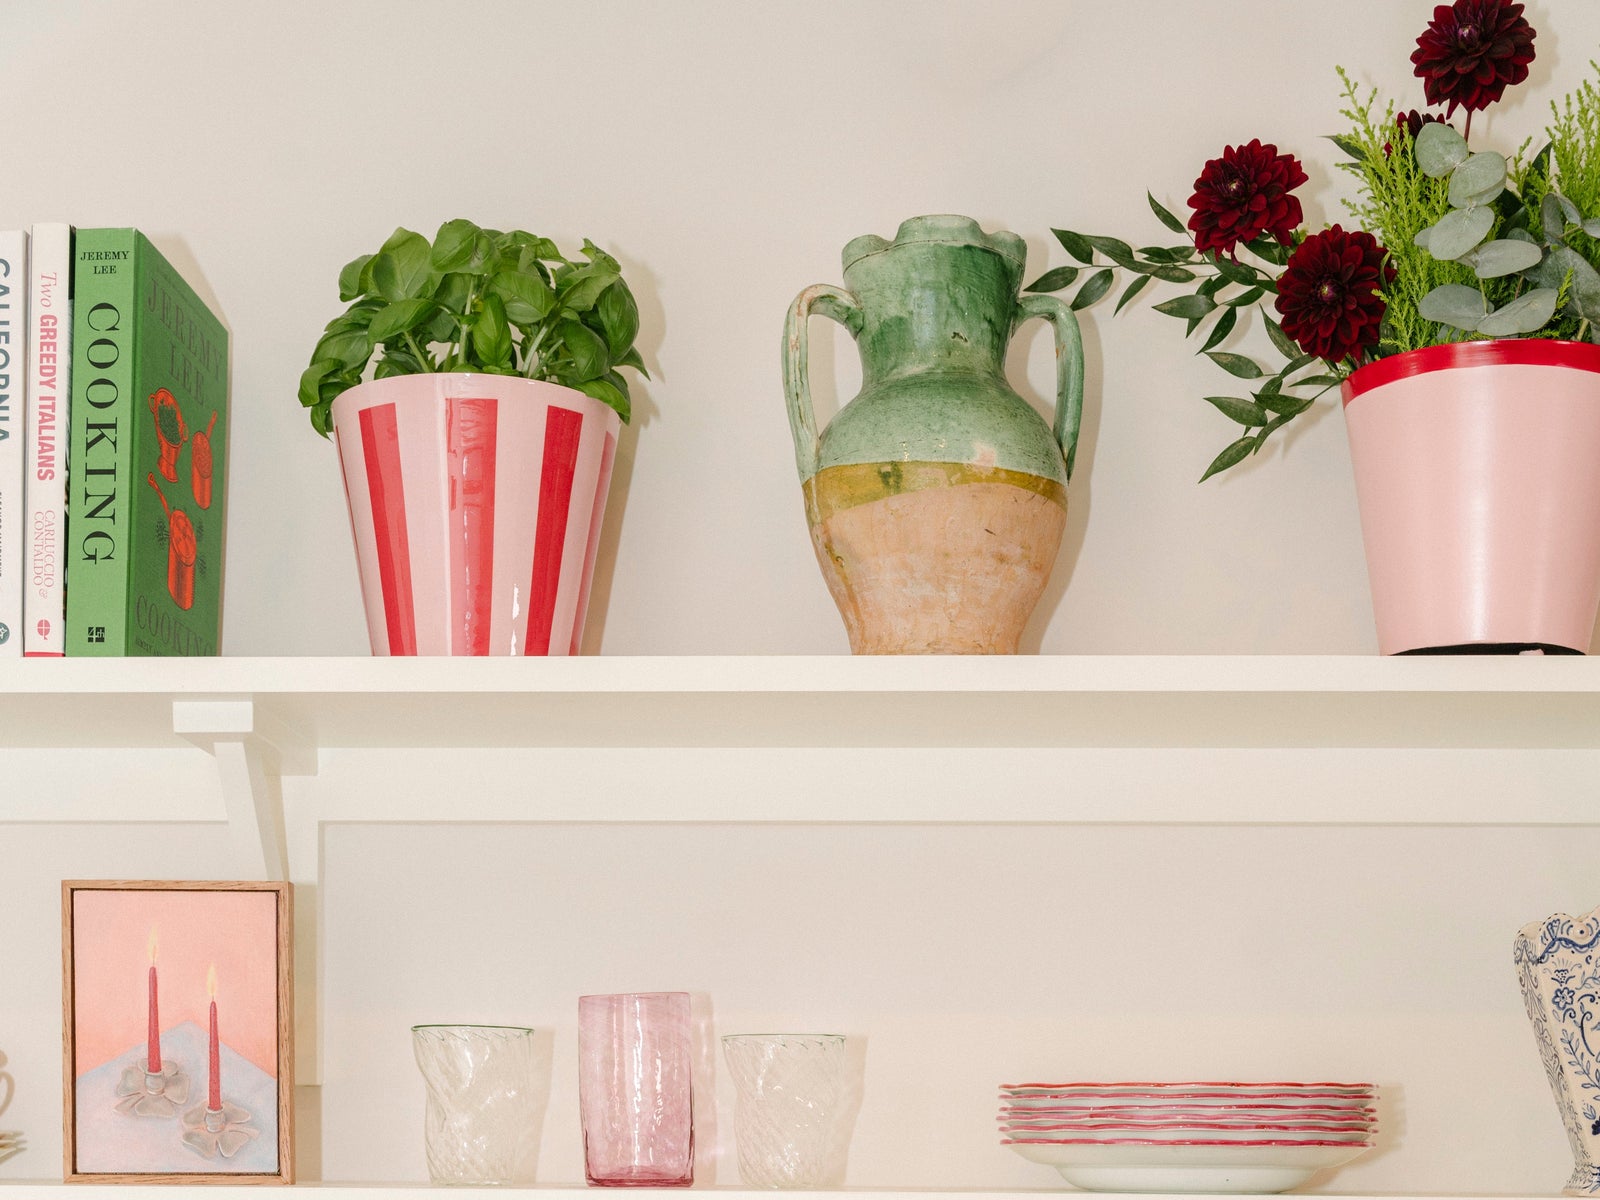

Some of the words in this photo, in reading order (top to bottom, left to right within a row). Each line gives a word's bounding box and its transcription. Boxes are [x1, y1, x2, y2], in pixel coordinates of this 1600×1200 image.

[40, 271, 57, 308] Two
[80, 250, 130, 261] JEREMY
[92, 265, 117, 275] LEE
[39, 314, 58, 390] GREEDY
[148, 277, 222, 382] JEREMY
[169, 342, 205, 407] LEE
[37, 396, 57, 482] ITALIANS
[82, 302, 121, 565] COOKING
[33, 511, 45, 586] CONTALDO
[44, 509, 56, 588] CARLUCCIO
